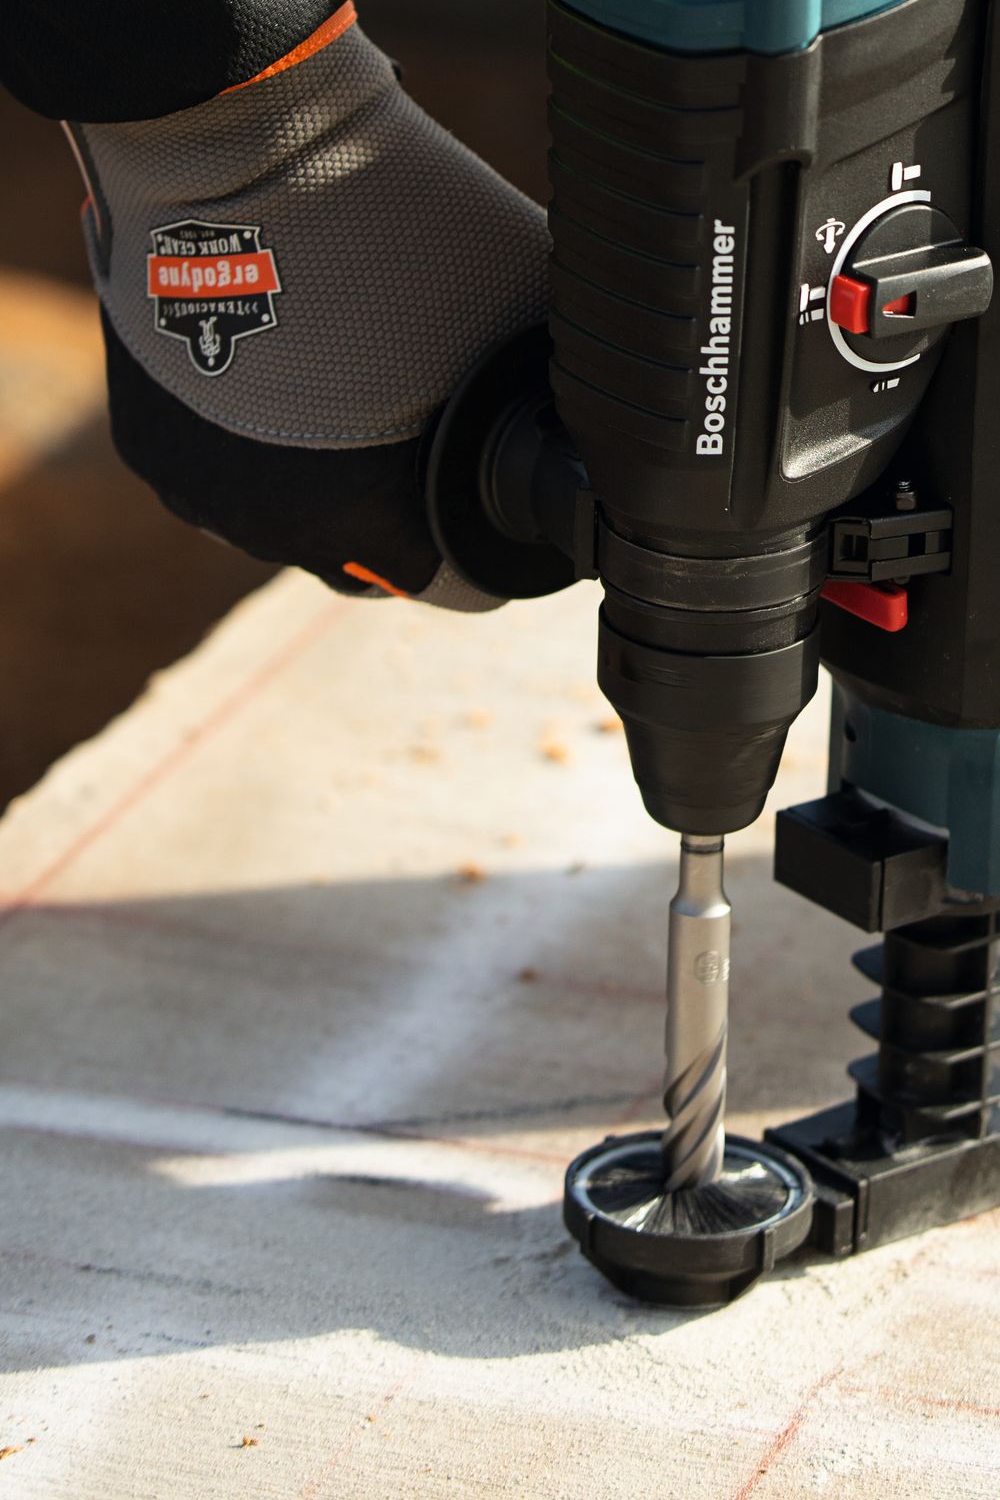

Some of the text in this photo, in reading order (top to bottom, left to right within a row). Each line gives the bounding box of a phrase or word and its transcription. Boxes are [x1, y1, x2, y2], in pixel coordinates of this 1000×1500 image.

[200, 233, 243, 256] WORK
[158, 260, 260, 293] ergodyne
[696, 219, 735, 455] Boschhammer
